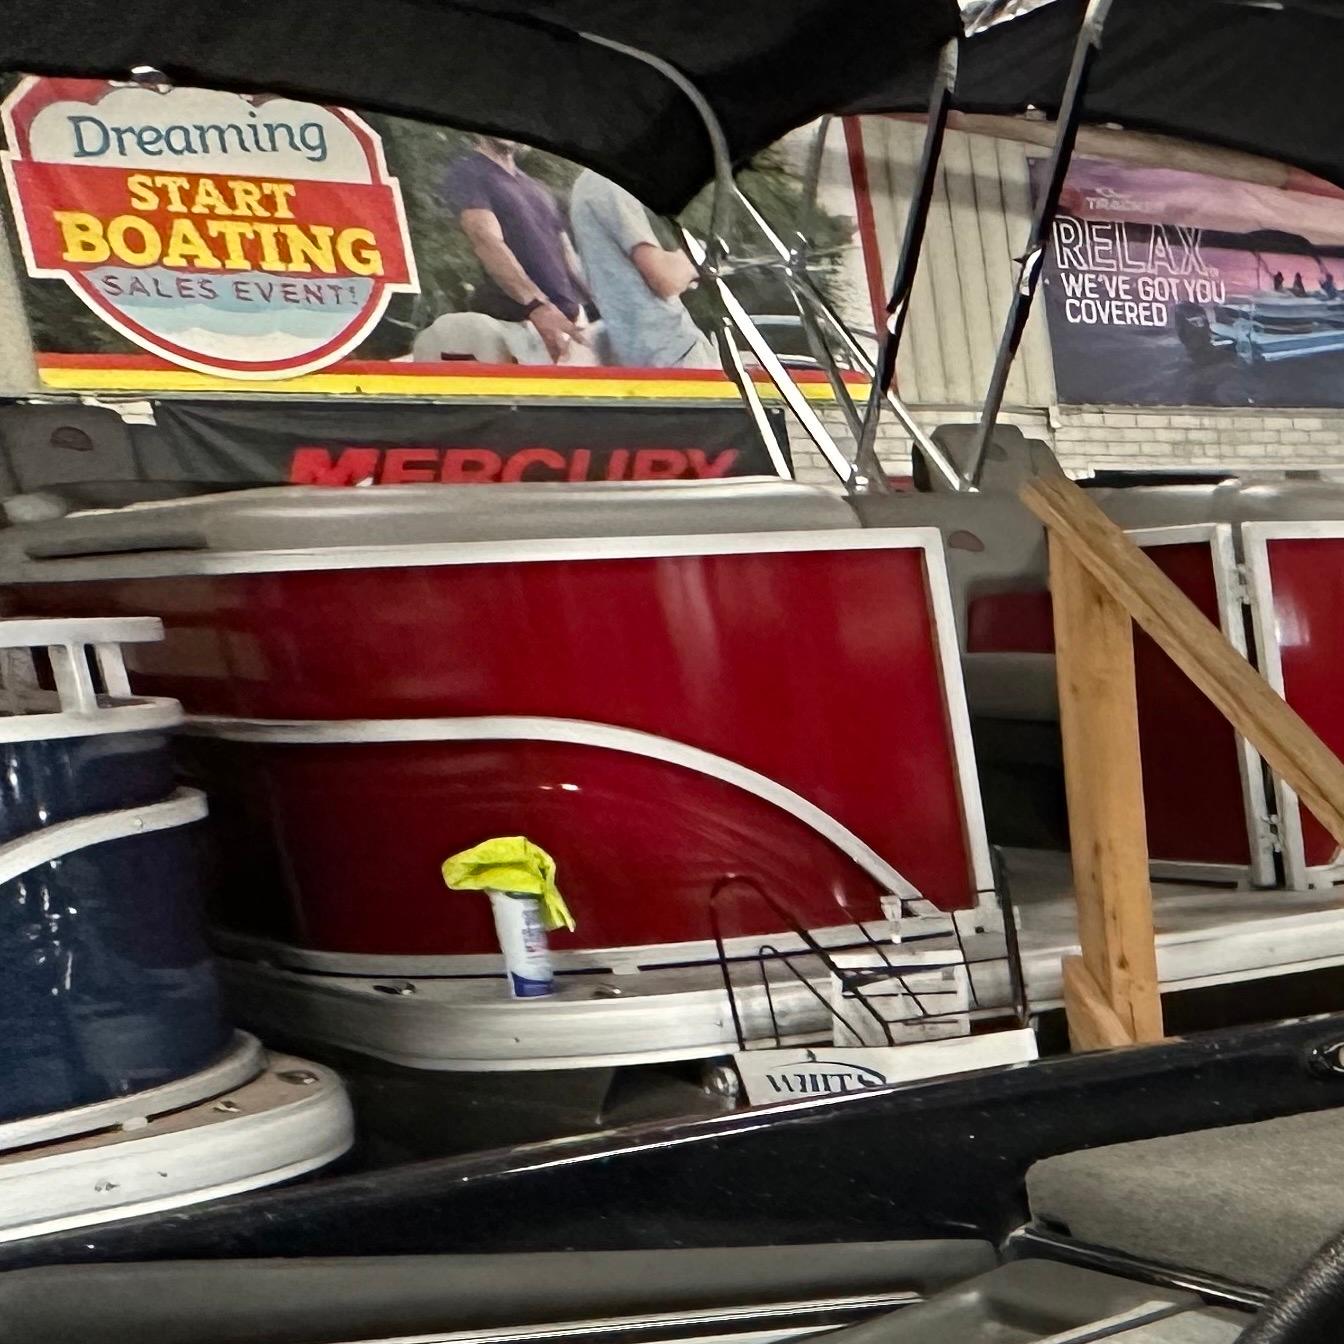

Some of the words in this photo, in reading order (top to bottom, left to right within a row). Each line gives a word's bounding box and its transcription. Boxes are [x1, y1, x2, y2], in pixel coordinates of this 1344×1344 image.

[67, 110, 329, 162] Dreaming
[127, 173, 297, 219] START
[53, 210, 385, 276] BOATING
[1052, 214, 1210, 276] RELAX
[101, 275, 219, 300] SALES
[232, 280, 358, 306] EVENT!
[1061, 272, 1133, 300] WE'VE
[1137, 277, 1181, 303] GOT
[1182, 278, 1226, 305] YOU
[1065, 298, 1169, 327] COVERED
[289, 447, 741, 486] MERCURY
